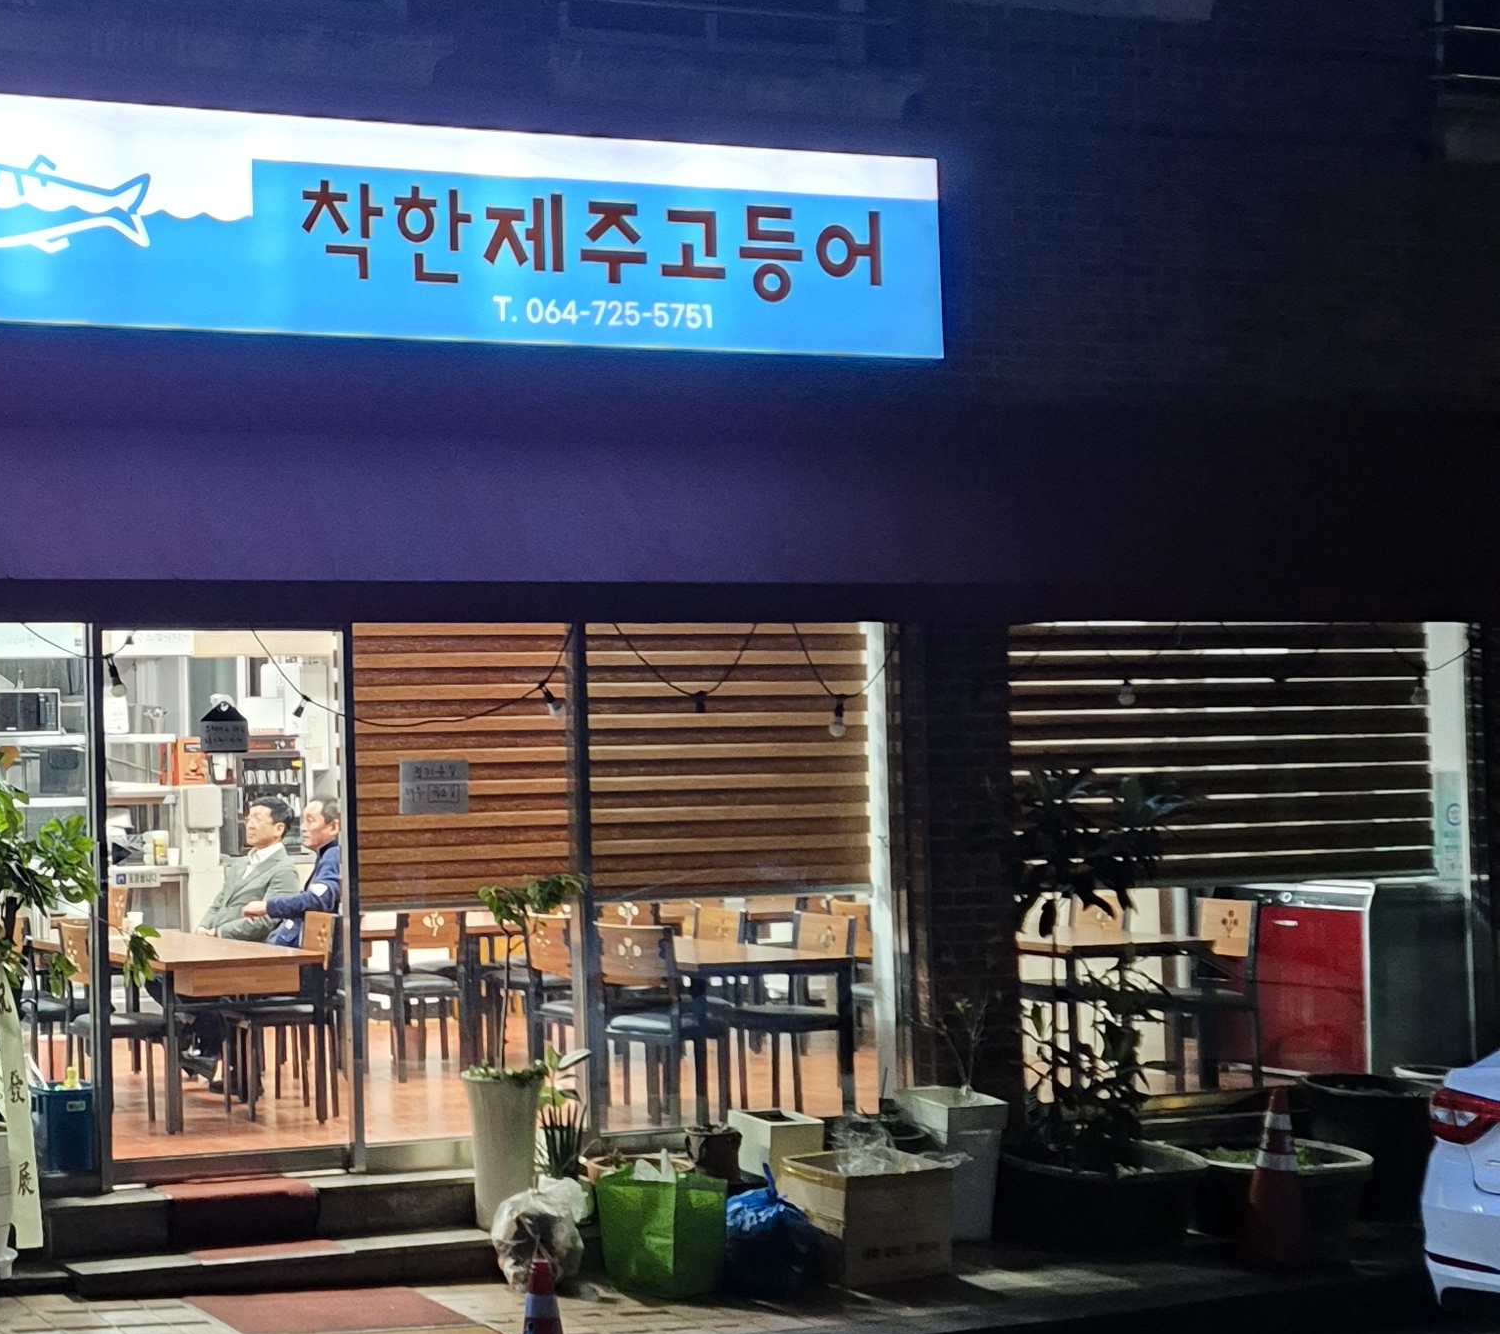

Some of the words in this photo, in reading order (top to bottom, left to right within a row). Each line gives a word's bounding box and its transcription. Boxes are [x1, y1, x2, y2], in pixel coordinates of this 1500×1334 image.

[301, 178, 882, 303] 착한제주고등어
[492, 294, 518, 324] T.
[525, 297, 714, 329] 064-725-5751
